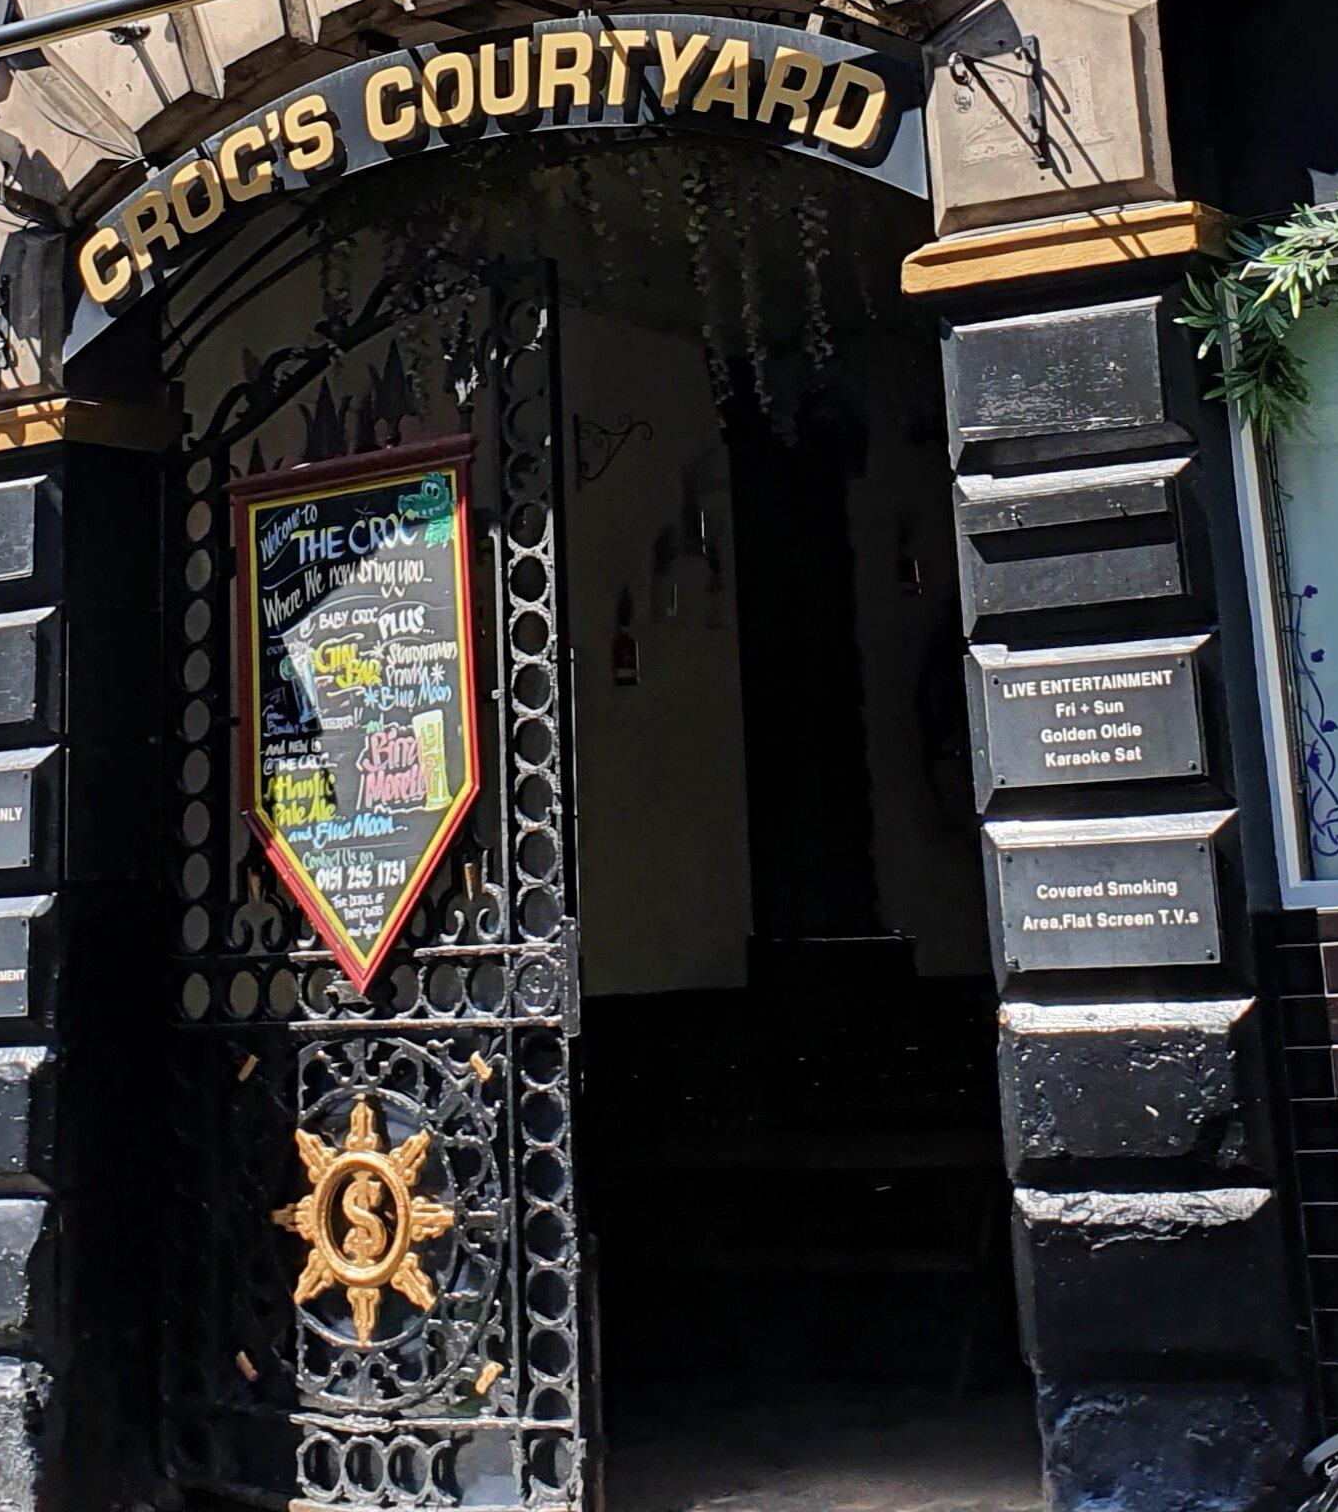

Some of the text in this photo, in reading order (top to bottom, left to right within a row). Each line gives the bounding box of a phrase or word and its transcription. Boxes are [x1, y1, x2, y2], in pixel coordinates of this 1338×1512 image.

[77, 27, 890, 307] CROC'S COURTYARD
[290, 509, 419, 565] THE CROC
[319, 610, 349, 629] BABY
[1003, 670, 1173, 699] LIVE ENTERTAINMENT
[379, 682, 452, 711] Blue Moon
[1056, 701, 1076, 718] Fri
[1094, 700, 1124, 715] Sun
[1041, 724, 1142, 744] Golden Oldie
[1046, 746, 1142, 767] Karaoke Sat
[1036, 879, 1178, 899] Covered Smoking
[1097, 911, 1154, 927] Screen
[1158, 908, 1199, 925] T.V.s
